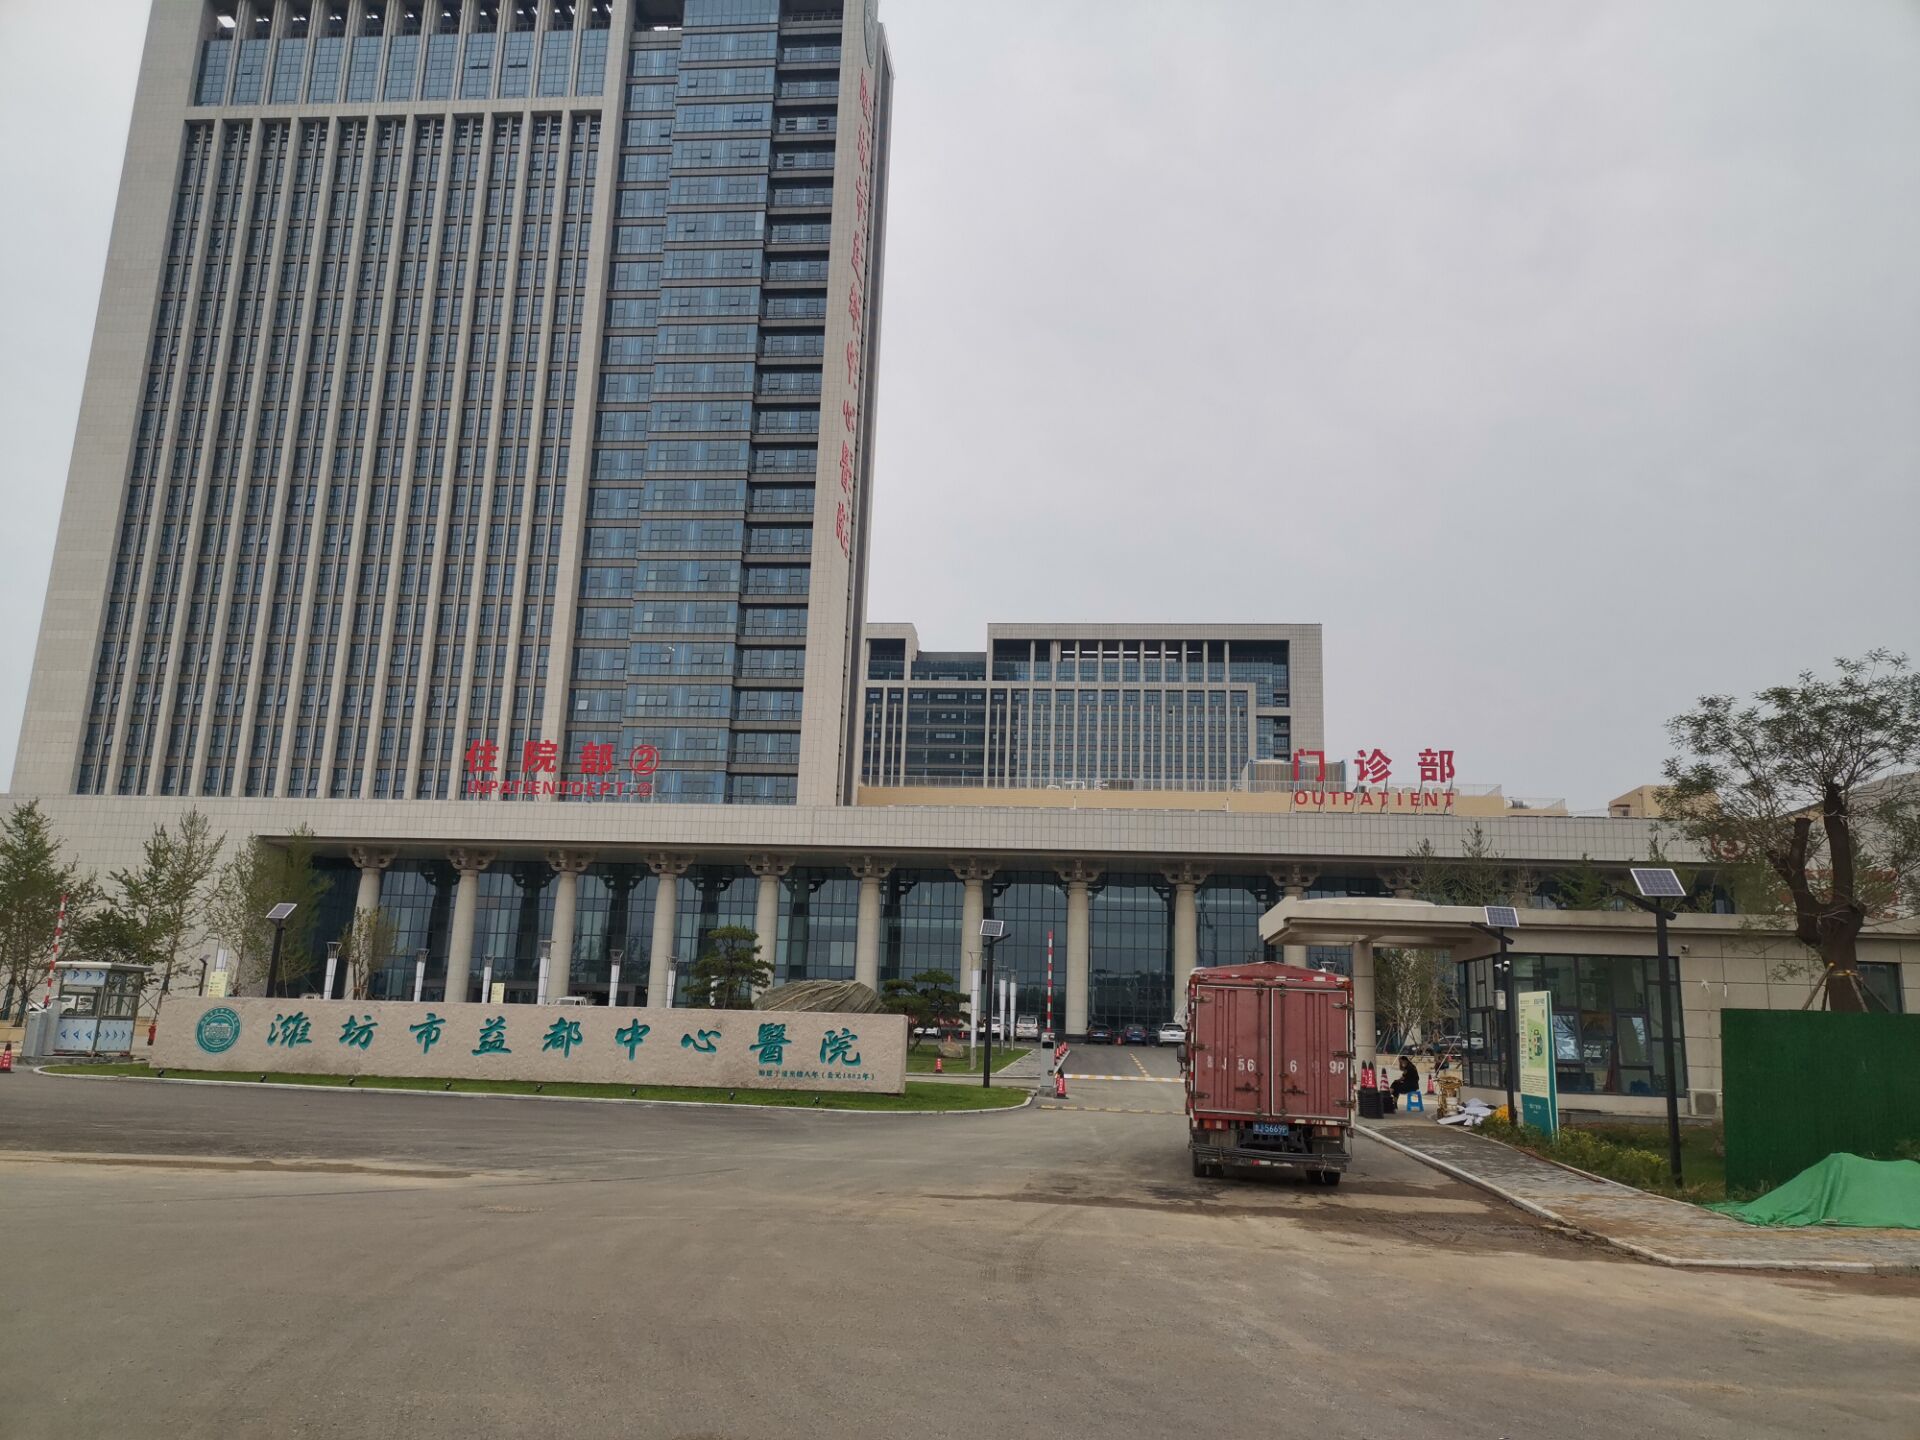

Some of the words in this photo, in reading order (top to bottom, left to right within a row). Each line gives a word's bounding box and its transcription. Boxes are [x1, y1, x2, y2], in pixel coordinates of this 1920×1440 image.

[1293, 748, 1455, 783] 门诊部
[1294, 790, 1455, 807] OUTPATIENT
